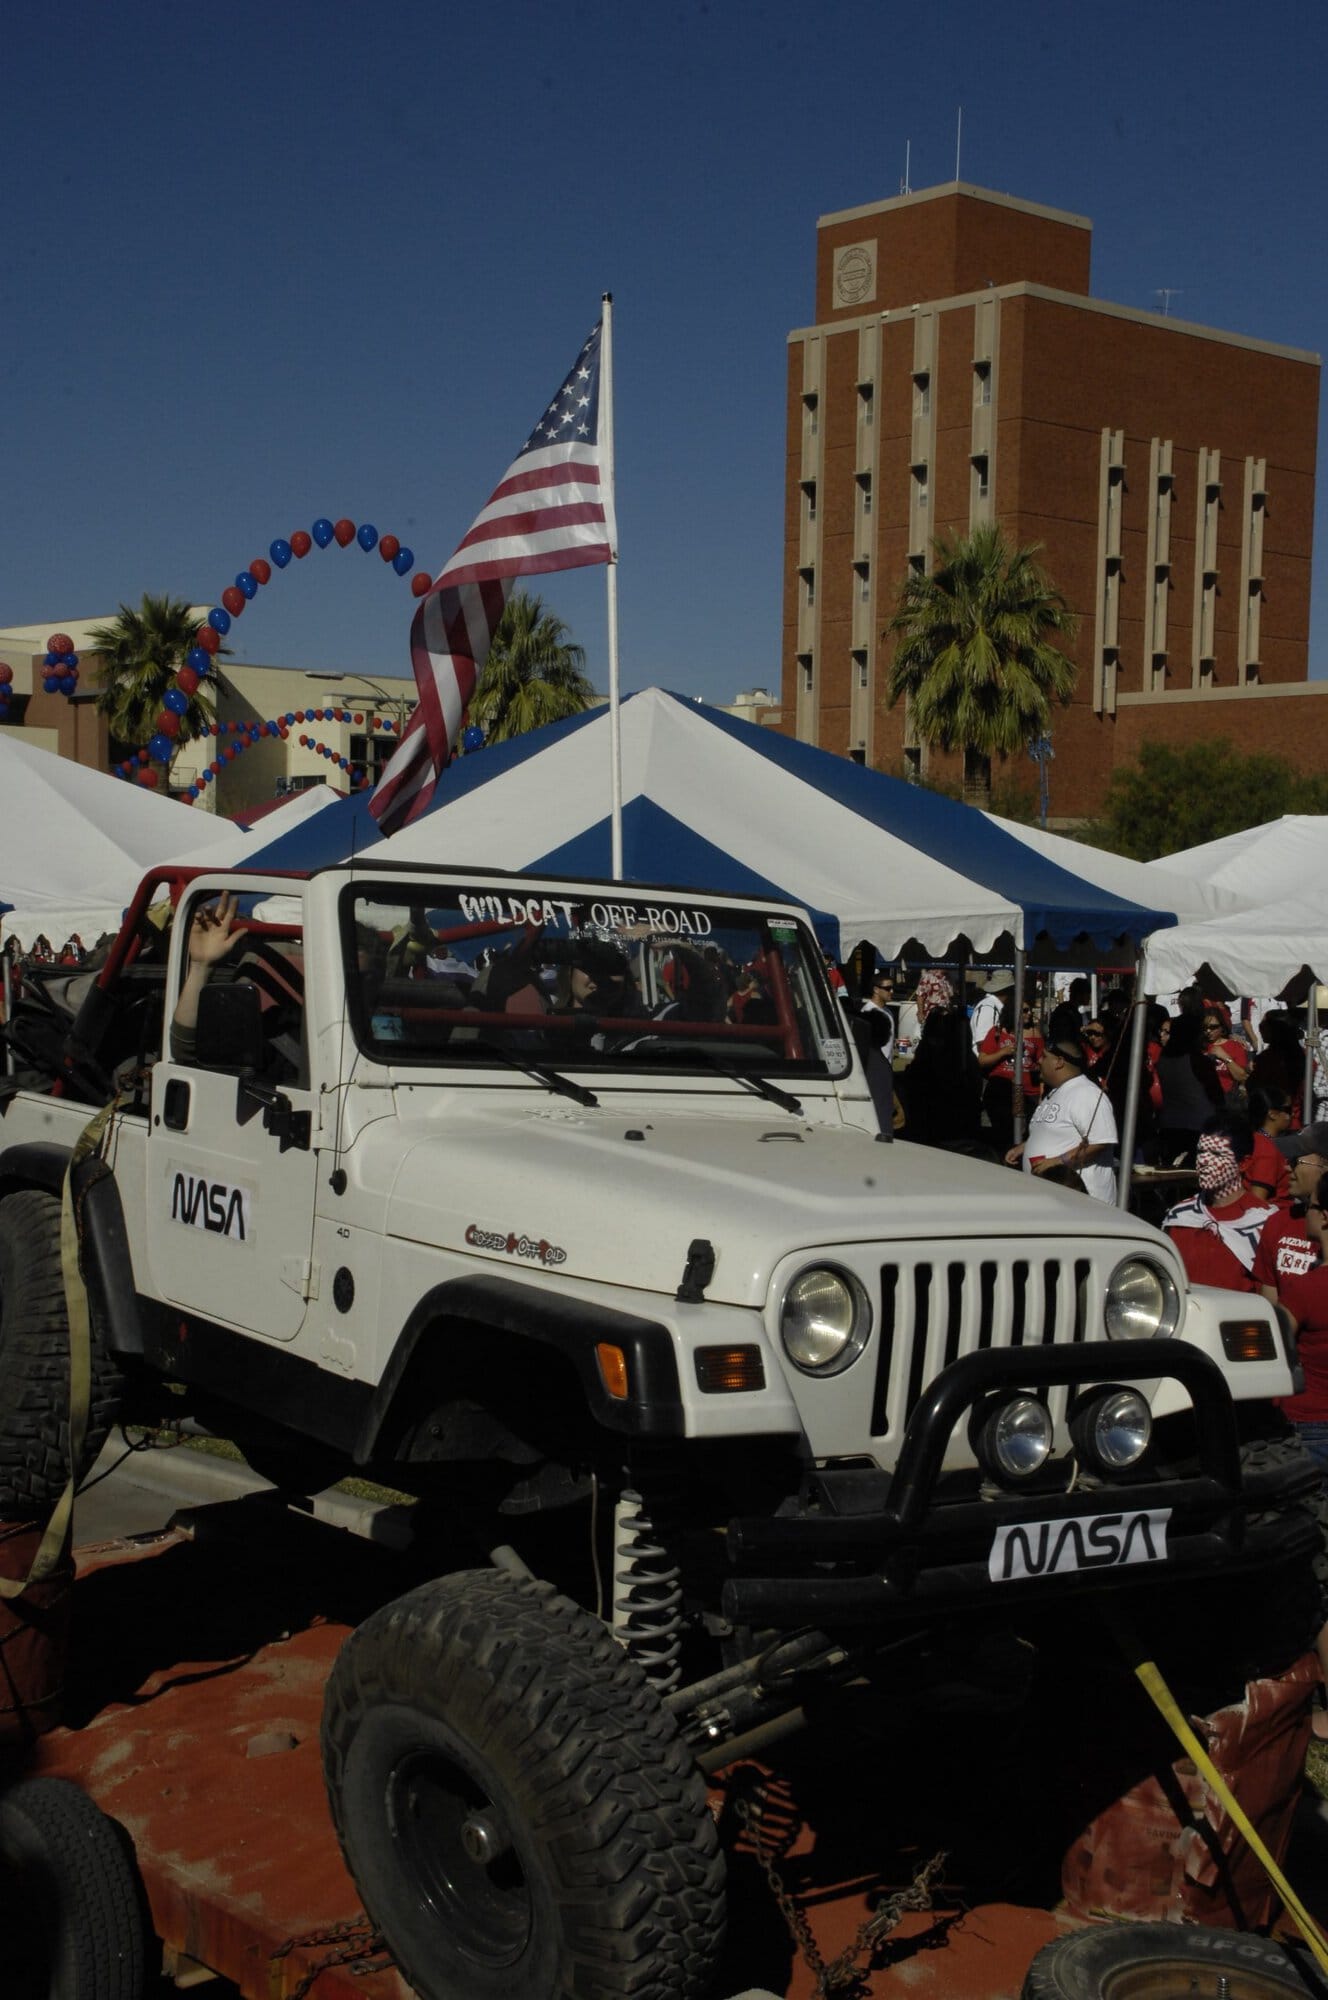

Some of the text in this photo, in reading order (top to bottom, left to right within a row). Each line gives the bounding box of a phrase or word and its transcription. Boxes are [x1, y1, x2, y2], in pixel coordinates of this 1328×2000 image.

[459, 894, 712, 935] WILDCAT OFF-ROAD
[172, 1173, 245, 1240] NASA
[1002, 1513, 1157, 1578] NASA
